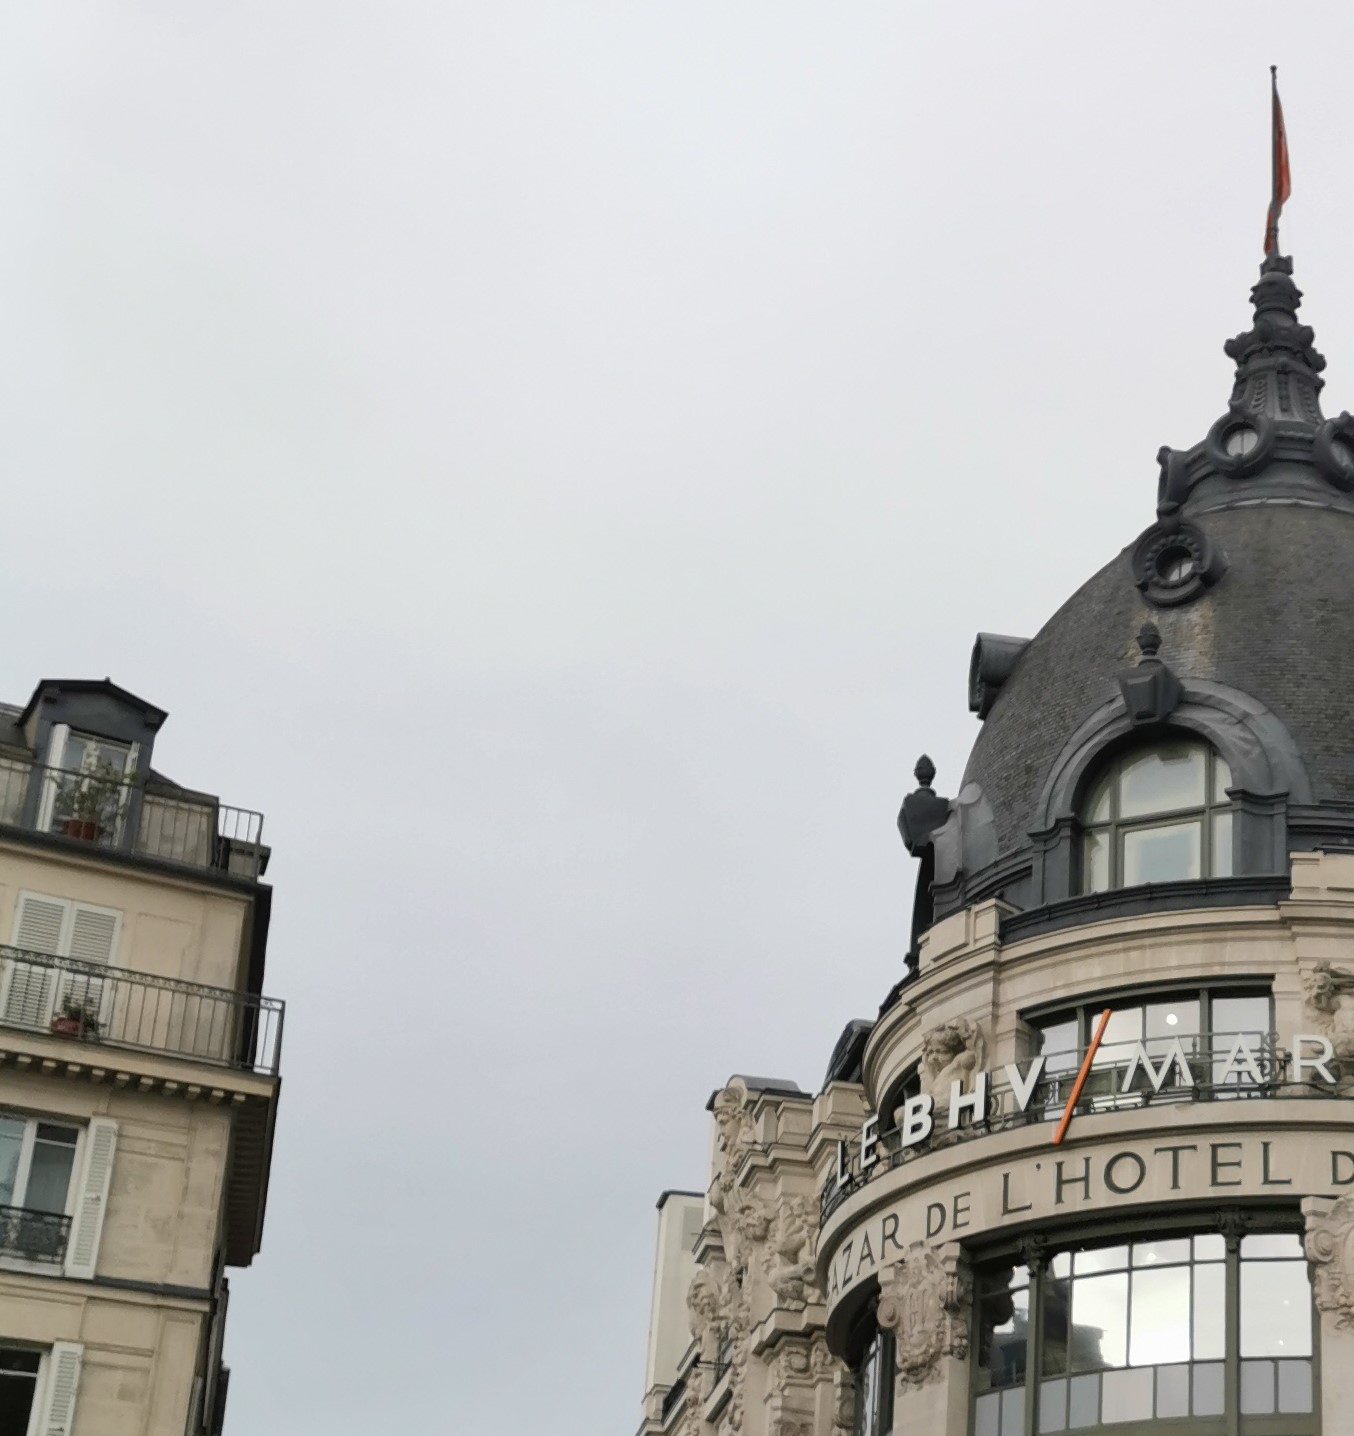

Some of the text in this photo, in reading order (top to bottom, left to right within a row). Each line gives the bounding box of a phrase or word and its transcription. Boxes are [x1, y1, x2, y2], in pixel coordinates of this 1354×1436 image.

[837, 1113, 879, 1188] LE
[828, 1212, 904, 1299] AZAR
[926, 1191, 971, 1240] DE
[1001, 1140, 1293, 1217] L'HOTEL
